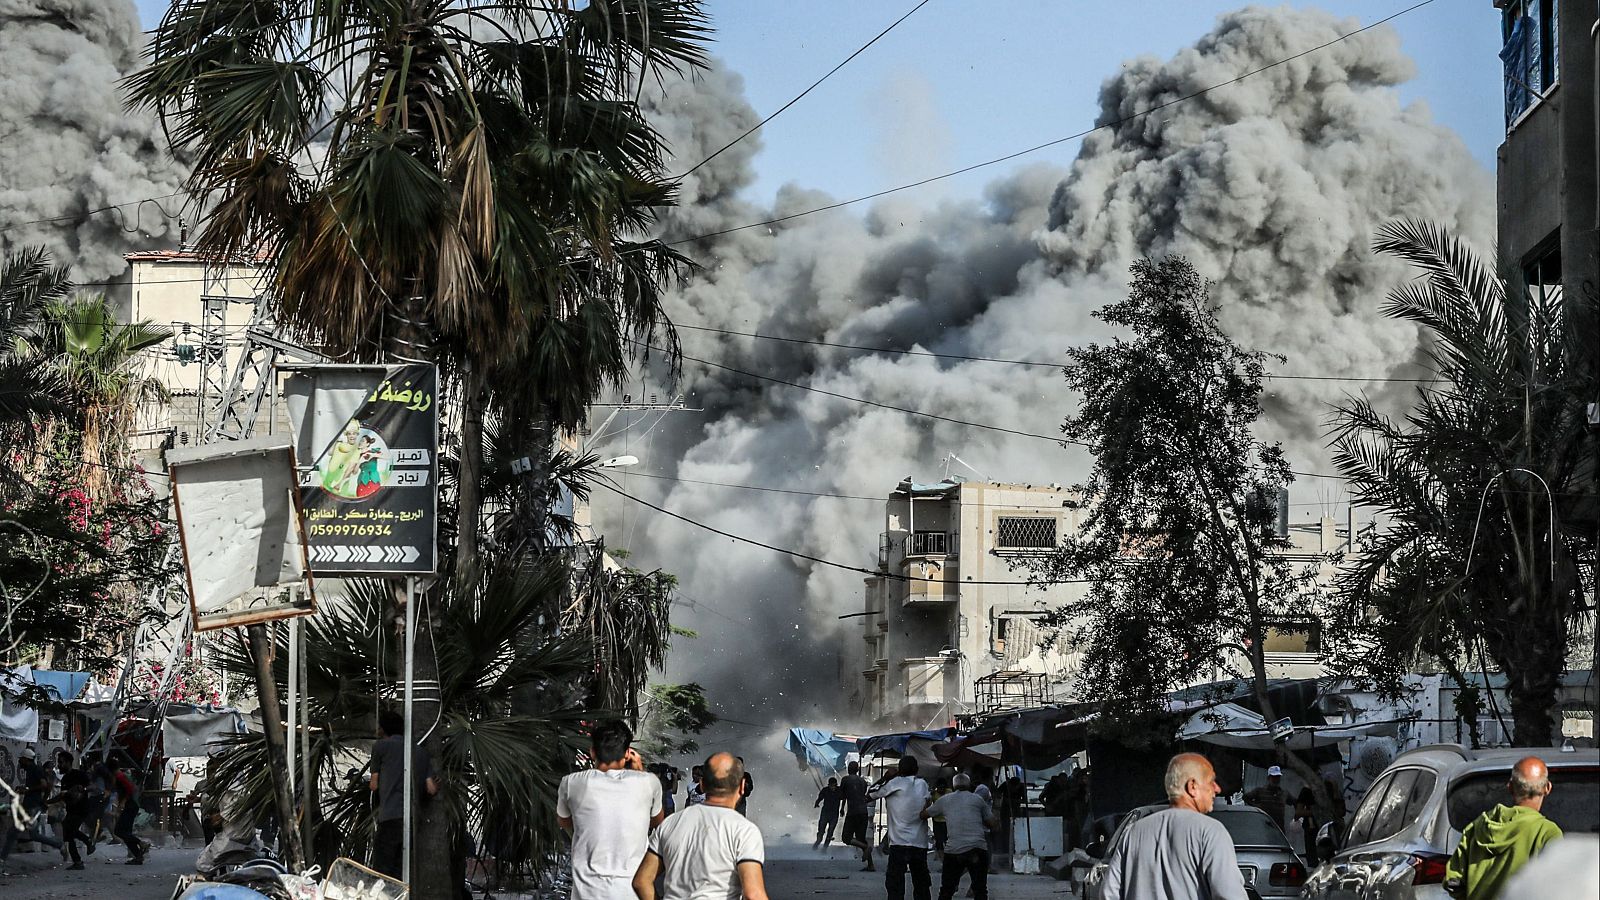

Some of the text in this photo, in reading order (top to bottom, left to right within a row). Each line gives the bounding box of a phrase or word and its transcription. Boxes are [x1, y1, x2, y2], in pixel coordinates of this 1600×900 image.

[379, 380, 431, 412] روضة
[396, 450, 422, 463] تميز
[397, 472, 419, 485] نجاح
[309, 508, 337, 521] الطابق
[342, 508, 368, 521] سكر
[368, 508, 394, 520] عمارة
[399, 508, 425, 521] البريج
[310, 524, 392, 536] 0599976934
